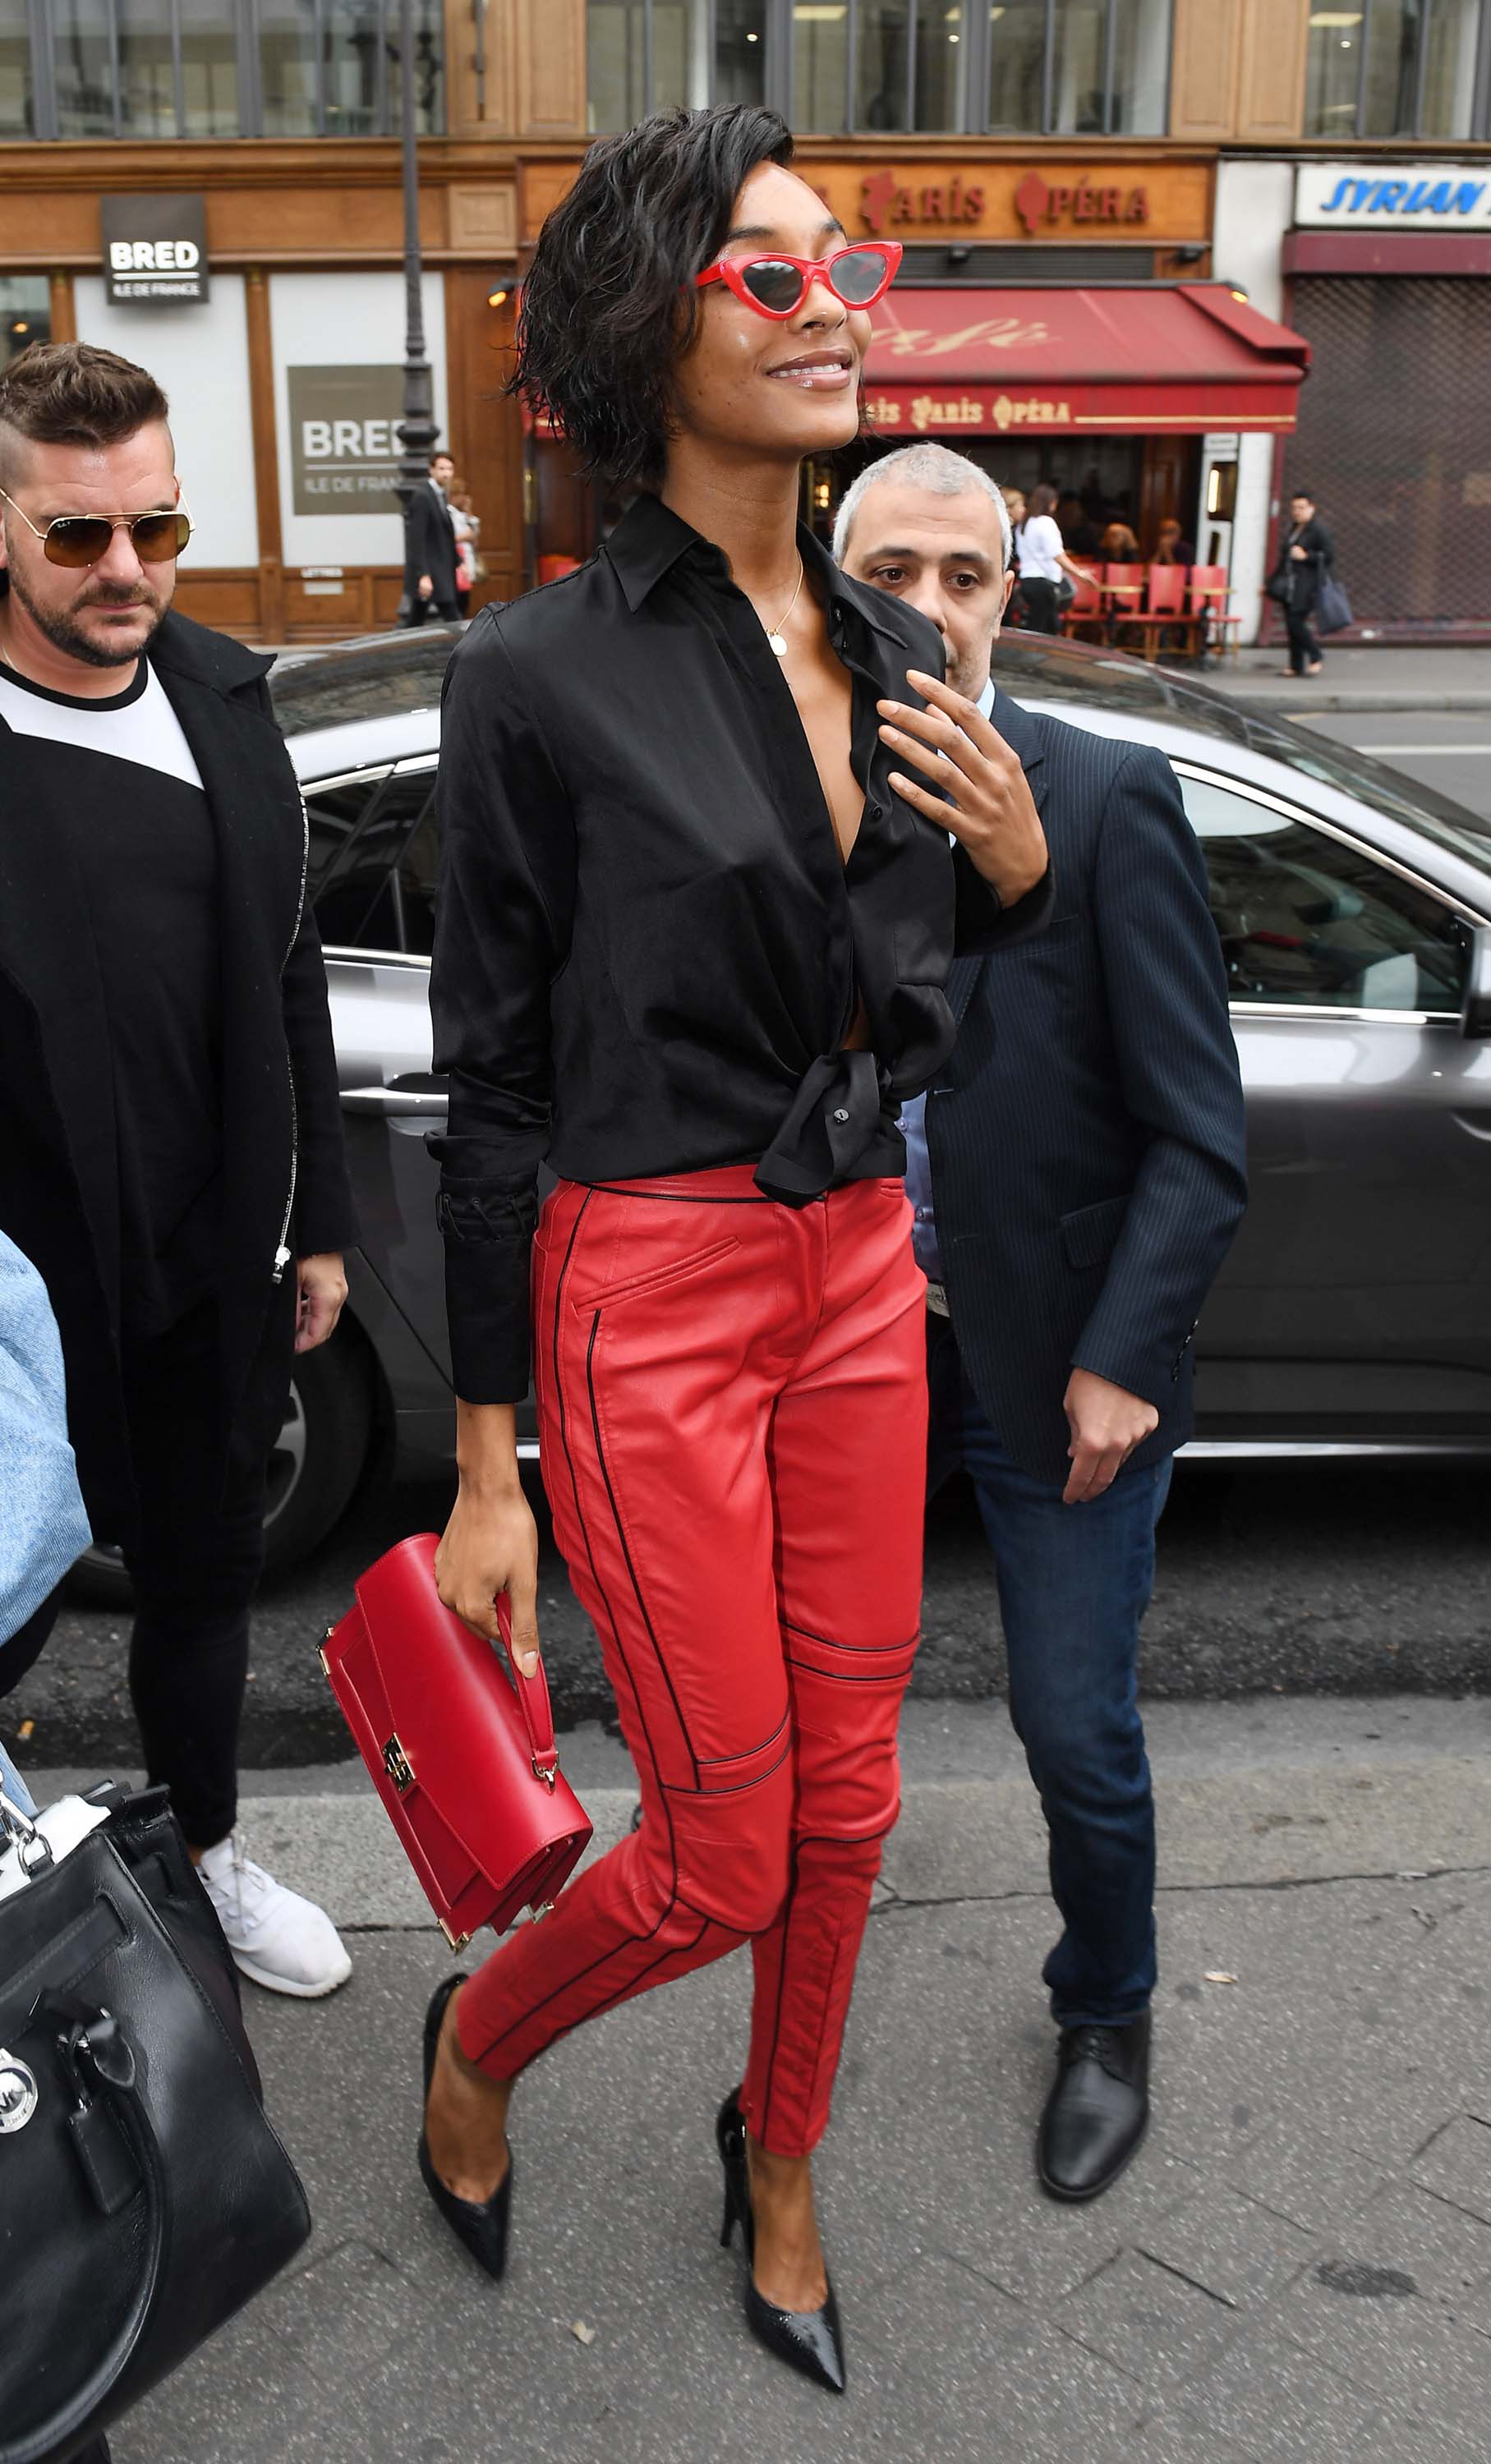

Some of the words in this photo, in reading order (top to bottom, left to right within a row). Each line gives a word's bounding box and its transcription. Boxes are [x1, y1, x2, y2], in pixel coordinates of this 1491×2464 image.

[1321, 176, 1486, 214] SYRIAN
[109, 241, 199, 270] BRED
[150, 282, 200, 297] FRANCE
[332, 476, 355, 493] DE
